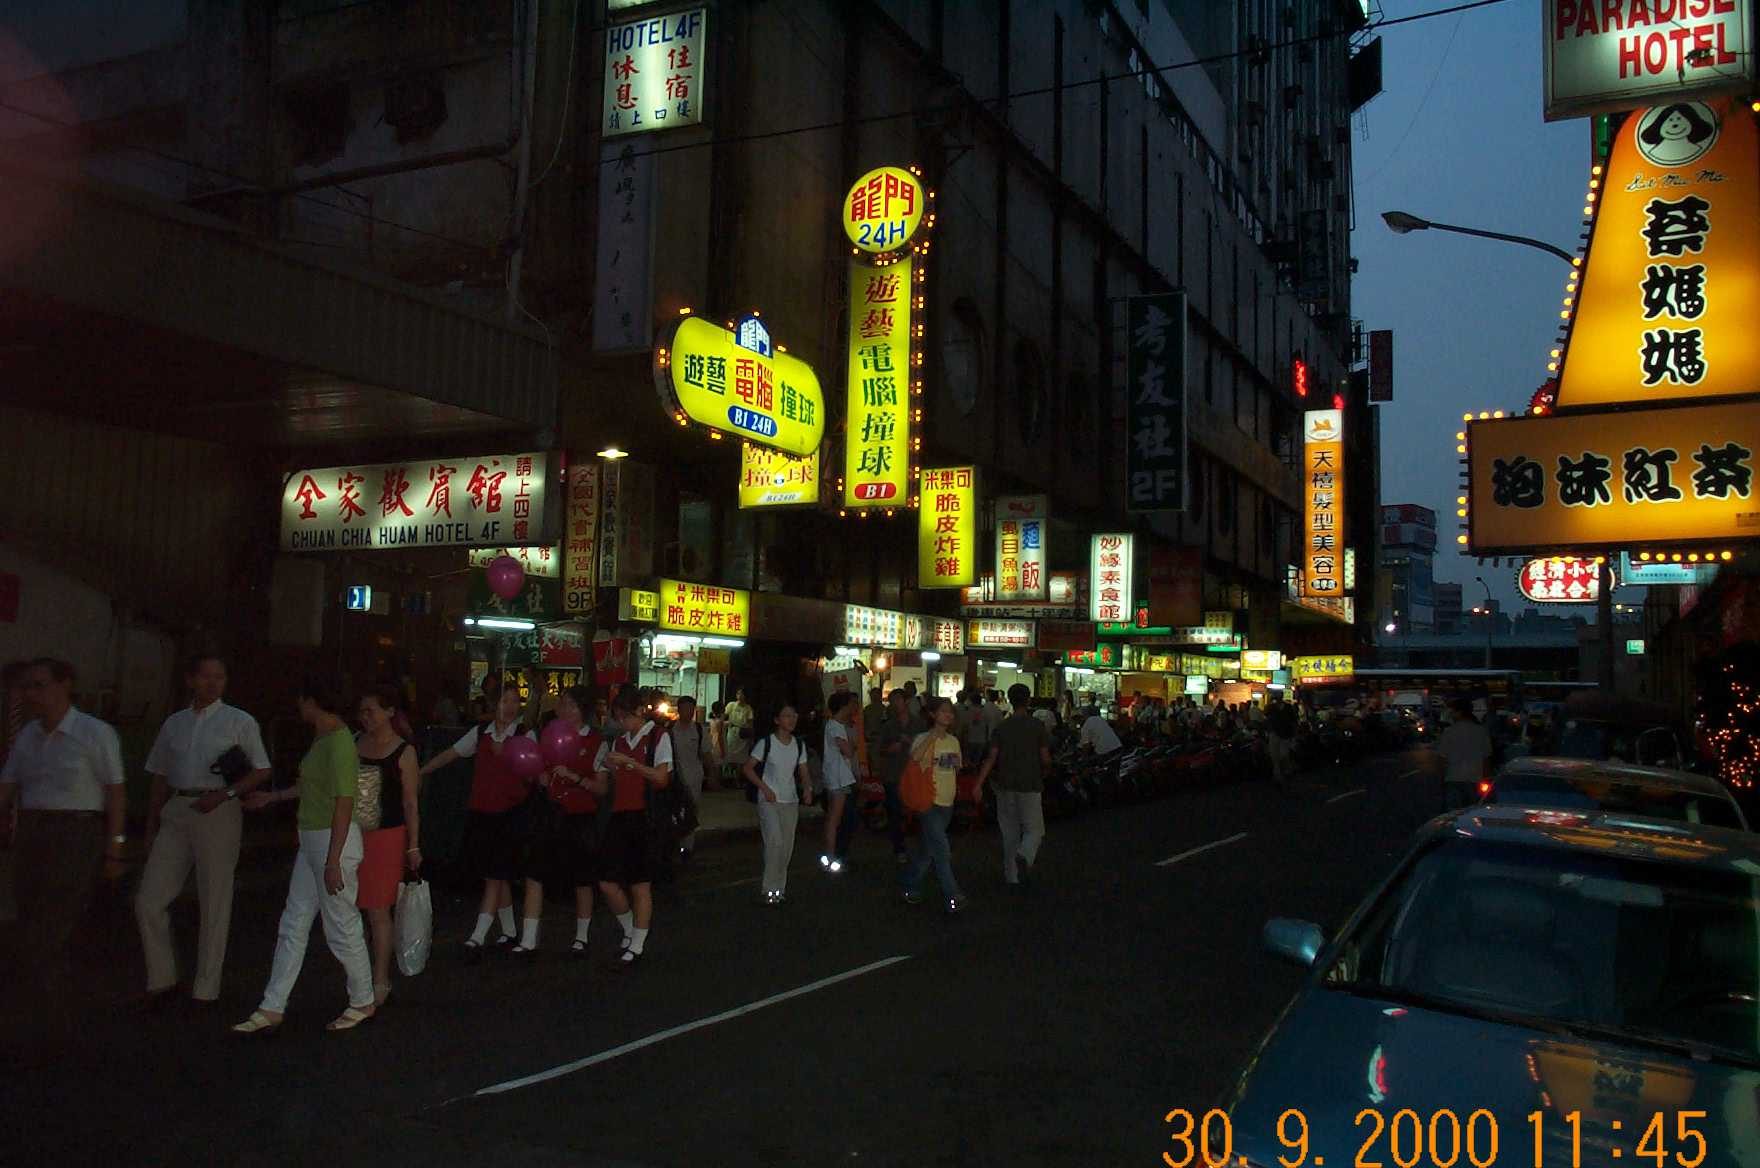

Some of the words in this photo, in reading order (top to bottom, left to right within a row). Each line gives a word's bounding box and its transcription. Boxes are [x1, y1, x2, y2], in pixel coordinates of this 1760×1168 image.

[609, 19, 672, 53] HOTEL
[675, 12, 700, 39] 4F
[1619, 23, 1736, 79] HOTEL
[612, 55, 639, 109] 休息
[666, 45, 692, 100] 住宿
[851, 173, 915, 222] 龍門
[858, 219, 906, 249] 24H
[734, 408, 749, 427] B1
[751, 412, 772, 435] 24H
[293, 460, 507, 523] 全家歡賓館
[513, 456, 533, 540] 請上四樓
[864, 484, 888, 498] B1
[1132, 469, 1176, 500] 2F
[1491, 444, 1751, 508] 泡沫紅茶
[291, 529, 335, 548] CHUAN
[342, 527, 372, 546] CHIA
[380, 525, 418, 544] HUAM
[425, 522, 474, 542] HOTEL
[481, 521, 500, 541] 4F
[934, 493, 961, 577] 脆皮炸雞
[567, 591, 593, 611] 9F
[1099, 536, 1122, 619] 妙緣素食館
[668, 605, 742, 632] 脆皮炸雞
